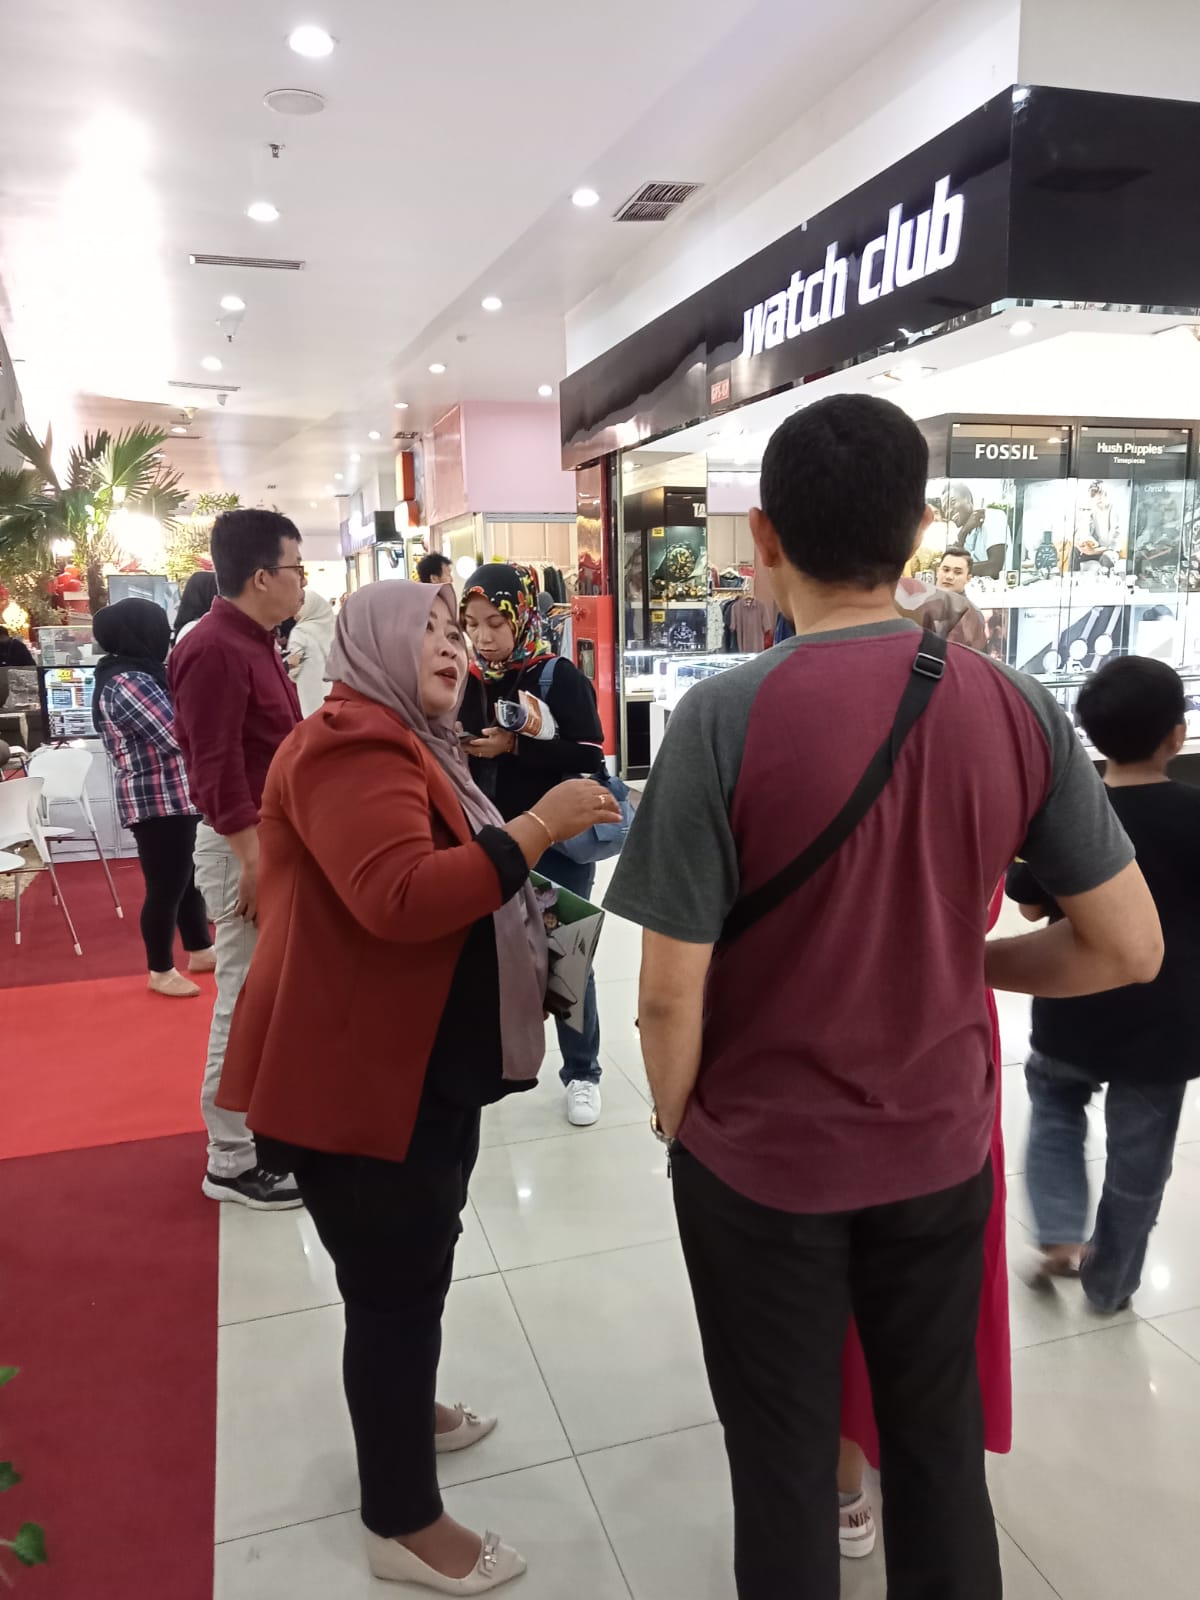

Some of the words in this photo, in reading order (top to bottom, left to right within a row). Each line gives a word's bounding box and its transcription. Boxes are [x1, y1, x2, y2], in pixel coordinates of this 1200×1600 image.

[743, 241, 848, 360] watch
[858, 175, 964, 305] club
[975, 443, 1039, 460] FOSSIL
[1097, 442, 1123, 453] Hush
[1124, 443, 1163, 456] Puppies
[848, 1506, 872, 1529] NIK
